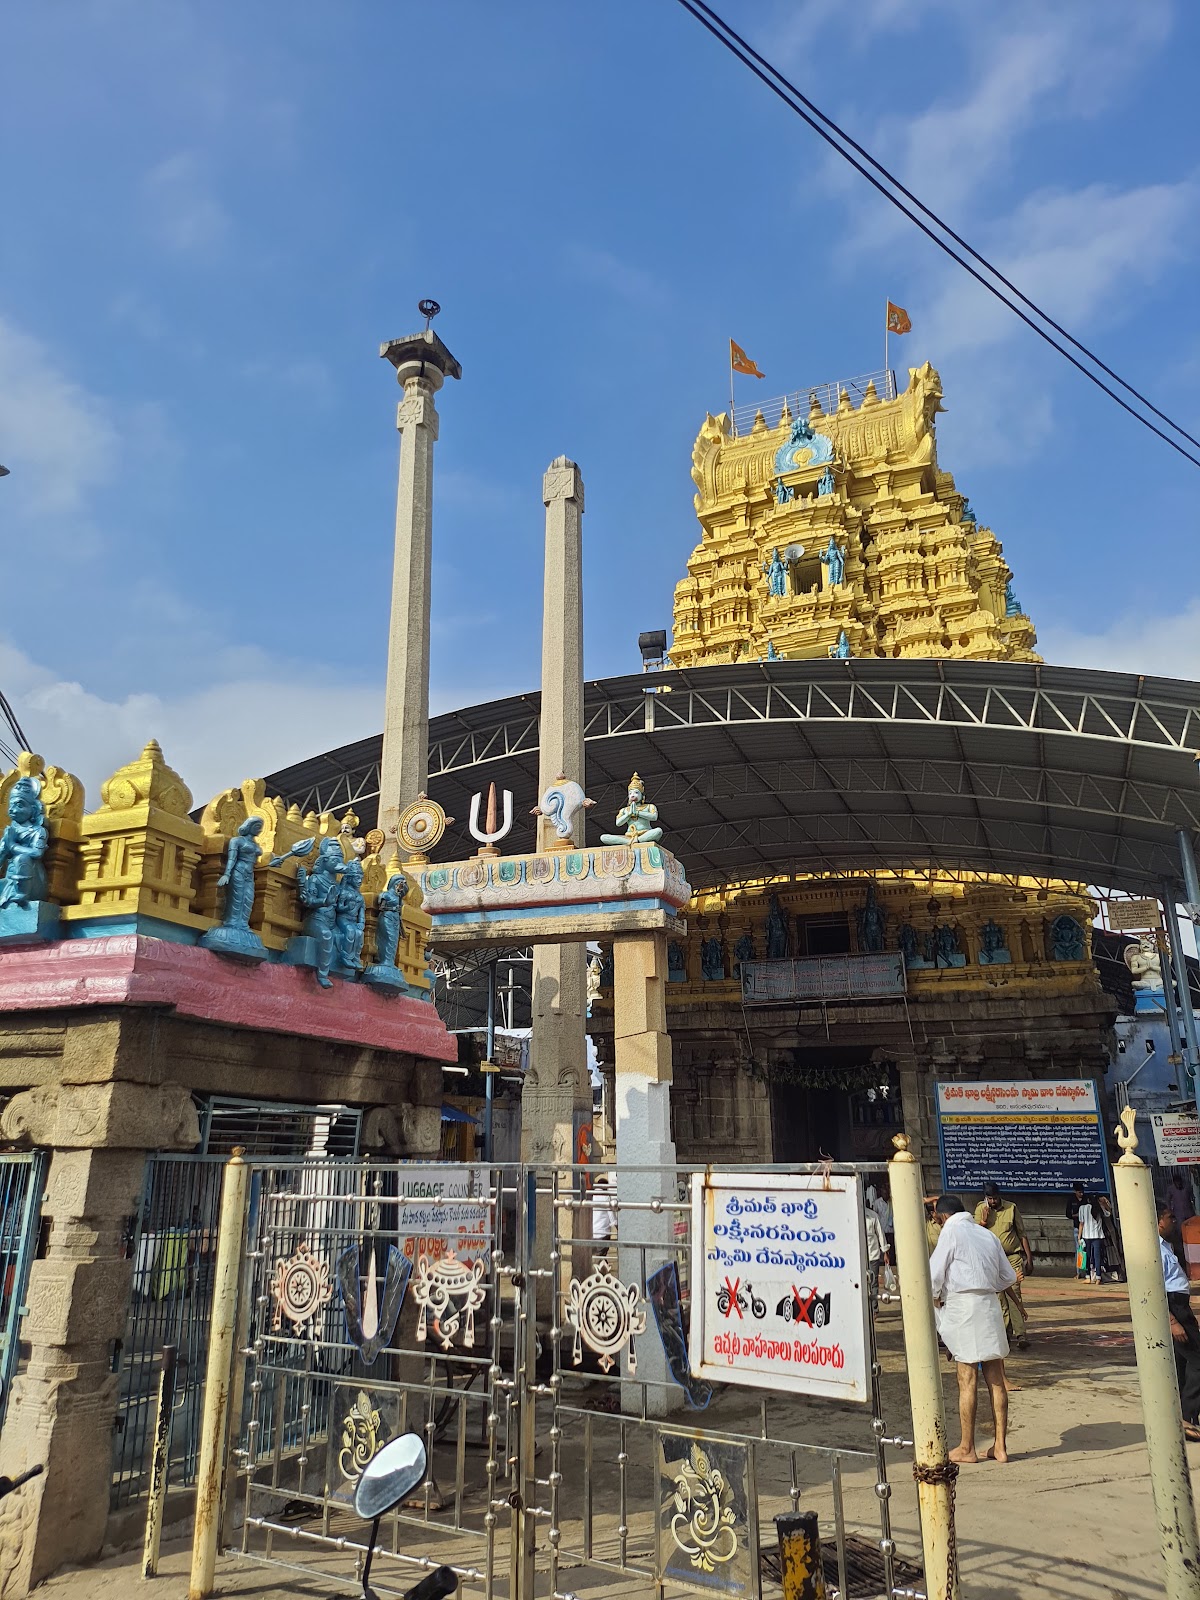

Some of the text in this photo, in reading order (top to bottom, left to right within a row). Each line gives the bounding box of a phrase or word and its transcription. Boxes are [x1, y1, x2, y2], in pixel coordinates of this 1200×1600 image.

[402, 1181, 483, 1198] LUGGAGE COUNER
[725, 1195, 777, 1216] శ్రీమత్
[713, 1217, 836, 1244] లక్ష్మీనరసింహ
[707, 1246, 846, 1273] స్వామి దేవస్థానము
[713, 1330, 845, 1369] ఇచ్చట వాహనాలు నిలపరాదు
